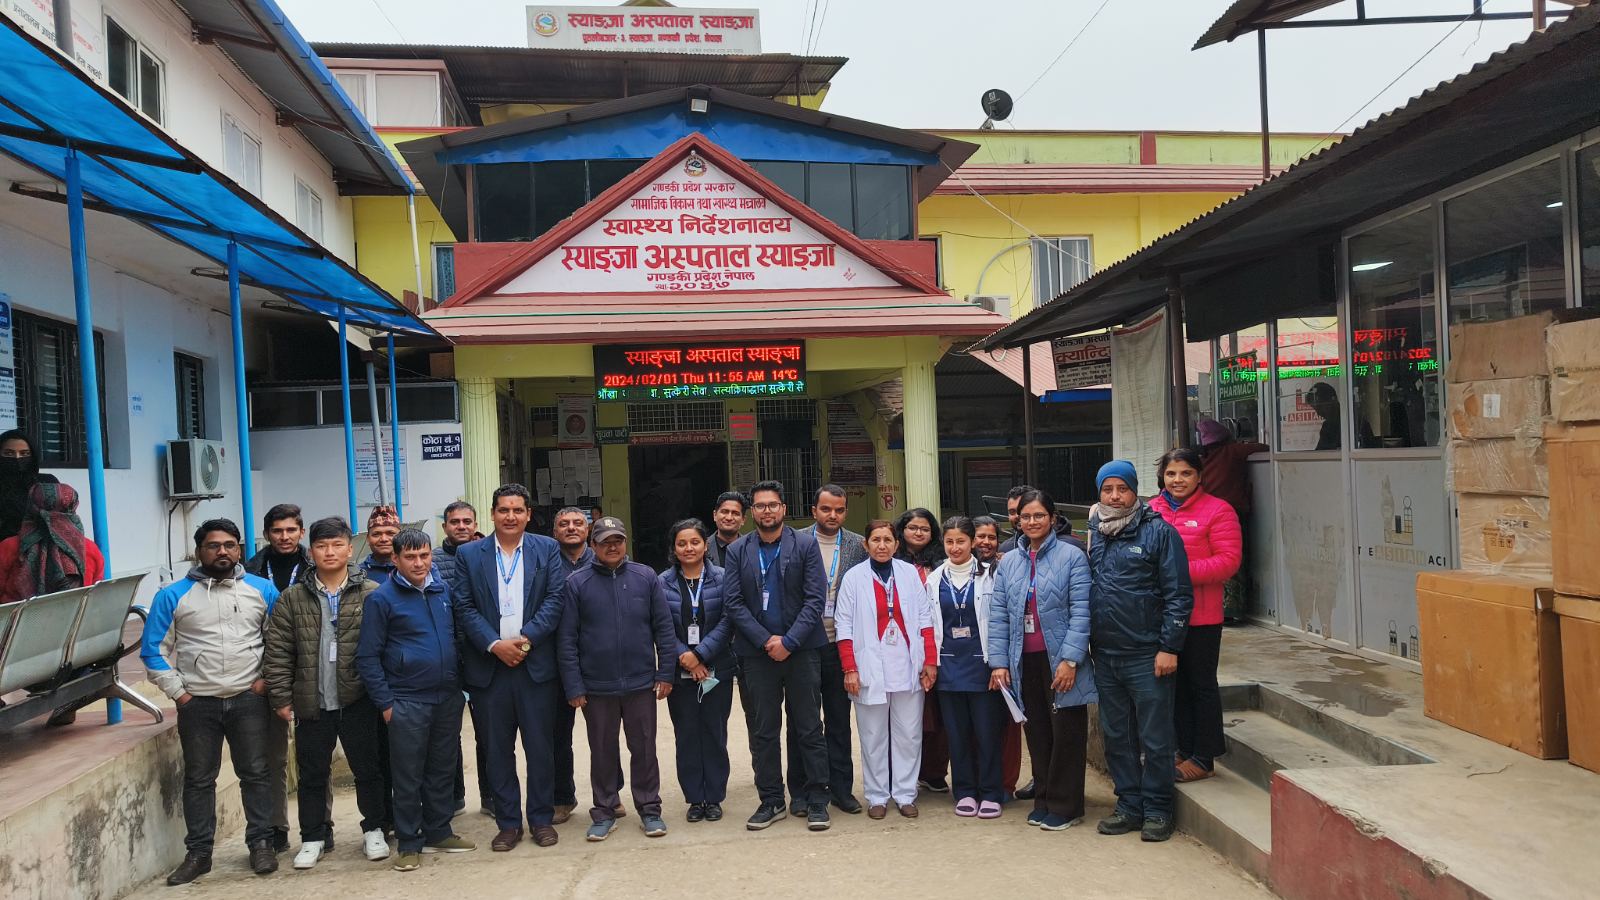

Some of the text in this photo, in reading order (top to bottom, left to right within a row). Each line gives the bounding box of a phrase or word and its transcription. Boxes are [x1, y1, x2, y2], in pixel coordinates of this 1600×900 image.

[631, 14, 694, 28] अस्पताल
[652, 181, 736, 193] गण्डकी प्रदेश सरकार
[630, 196, 668, 210] सामाजिक
[669, 196, 695, 210] विकास
[696, 198, 711, 210] तथा
[712, 198, 737, 210] स्वास्थ्य
[602, 214, 793, 236] स्वास्थ्य निर्देशनालय
[561, 243, 837, 274] स्याङ्जा अस्पताल स्याङ्जा
[647, 271, 691, 282] गण्डकी
[723, 269, 755, 281] नेपाल
[624, 345, 800, 368] स्याङ्जा अस्पताल स्याङ्जा
[1055, 345, 1111, 363] क्यान्टि
[604, 373, 677, 387] 2024/02/01
[681, 372, 705, 384] Thu
[747, 370, 765, 382] AM
[795, 380, 804, 392] से
[1219, 382, 1257, 398] PHARMACY
[424, 445, 442, 453] नाम
